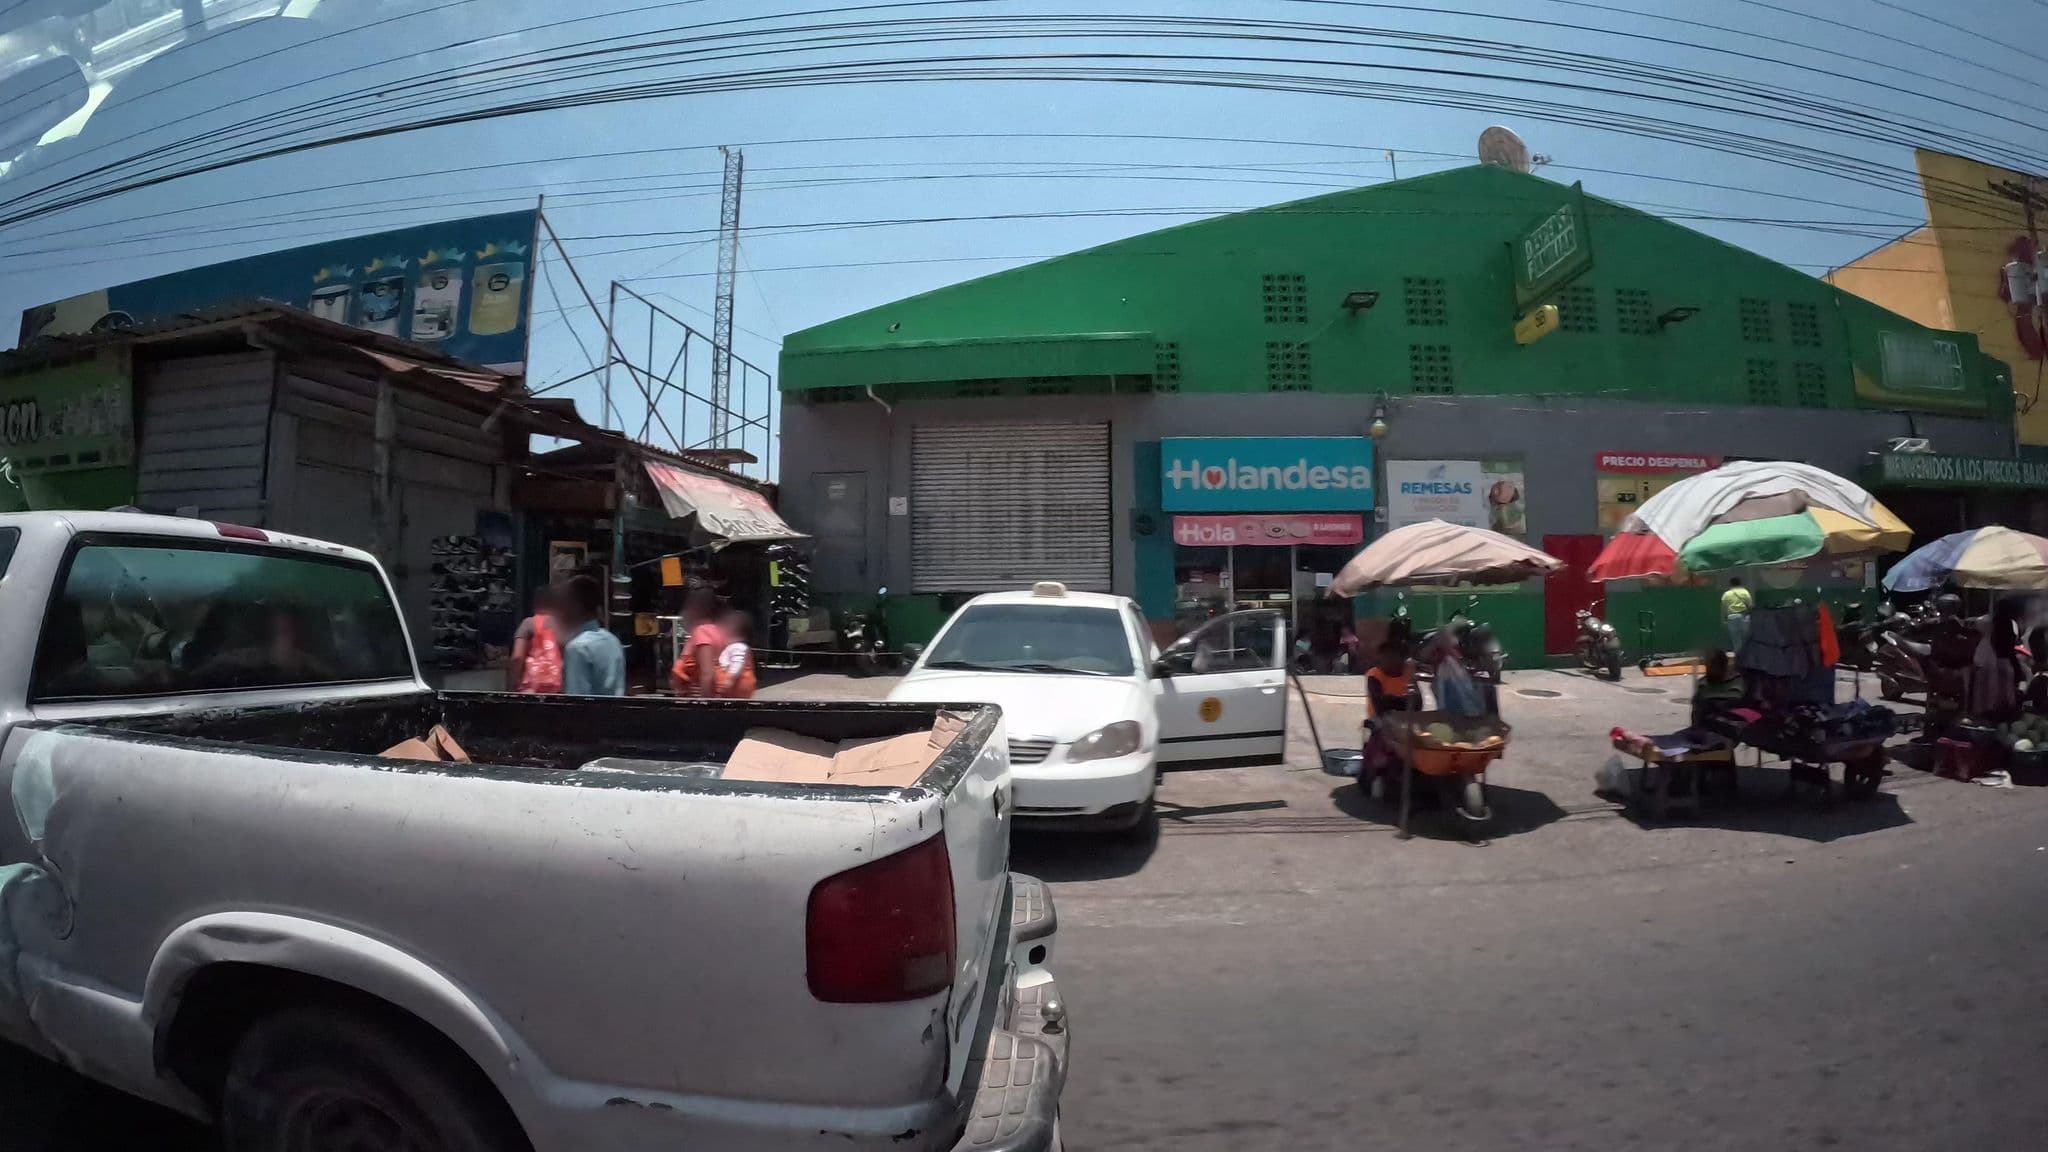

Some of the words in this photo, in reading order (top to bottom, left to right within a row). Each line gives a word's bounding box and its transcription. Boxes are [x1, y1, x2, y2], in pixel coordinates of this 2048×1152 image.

[1602, 456, 1646, 467] PRECIO
[1648, 457, 1707, 469] DESPENSA
[1964, 457, 1982, 481] LOS
[1166, 457, 1371, 491] Holandesa
[1401, 481, 1473, 495] REMESAS
[1178, 521, 1236, 543] Hola
